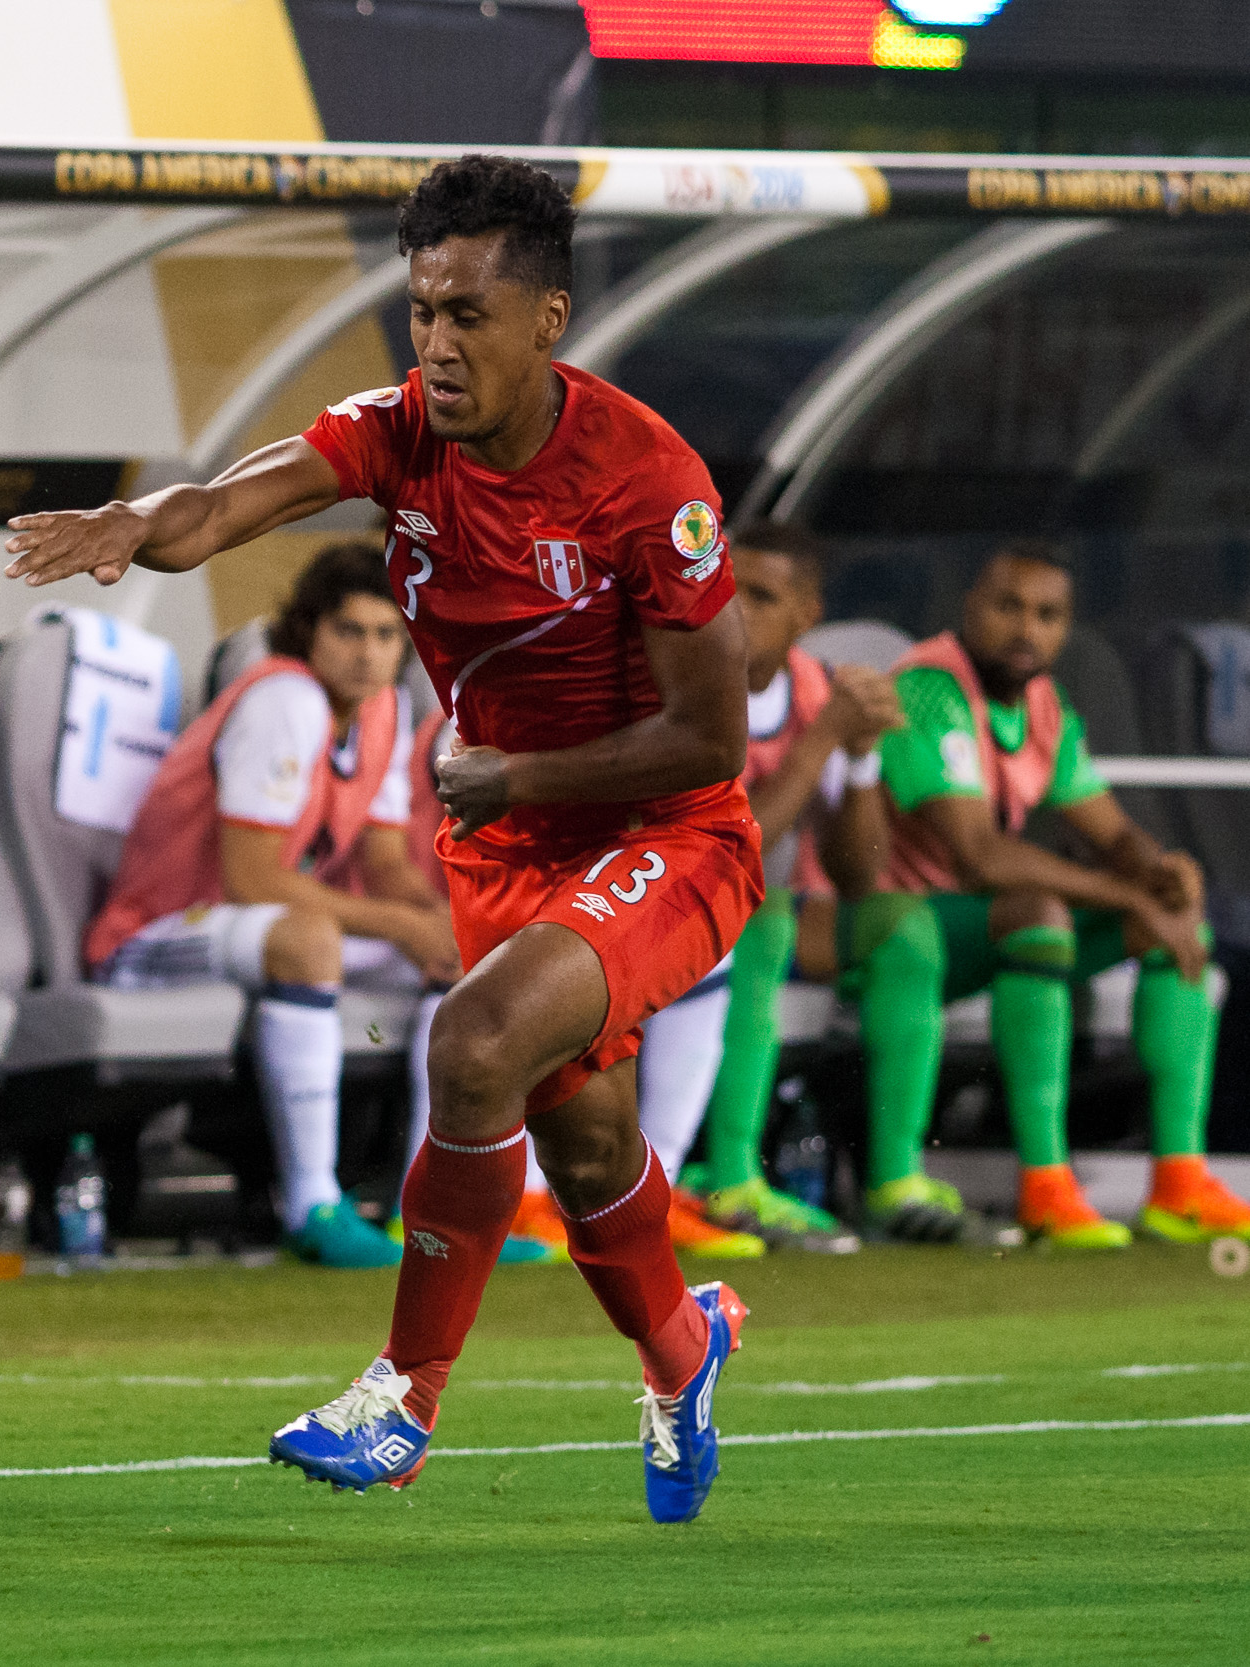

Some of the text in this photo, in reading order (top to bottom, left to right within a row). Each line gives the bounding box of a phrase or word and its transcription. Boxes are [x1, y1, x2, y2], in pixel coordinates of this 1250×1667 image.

[55, 153, 135, 191] COPA
[395, 523, 428, 546] umbro
[582, 848, 667, 905] 13
[571, 901, 605, 922] umbro
